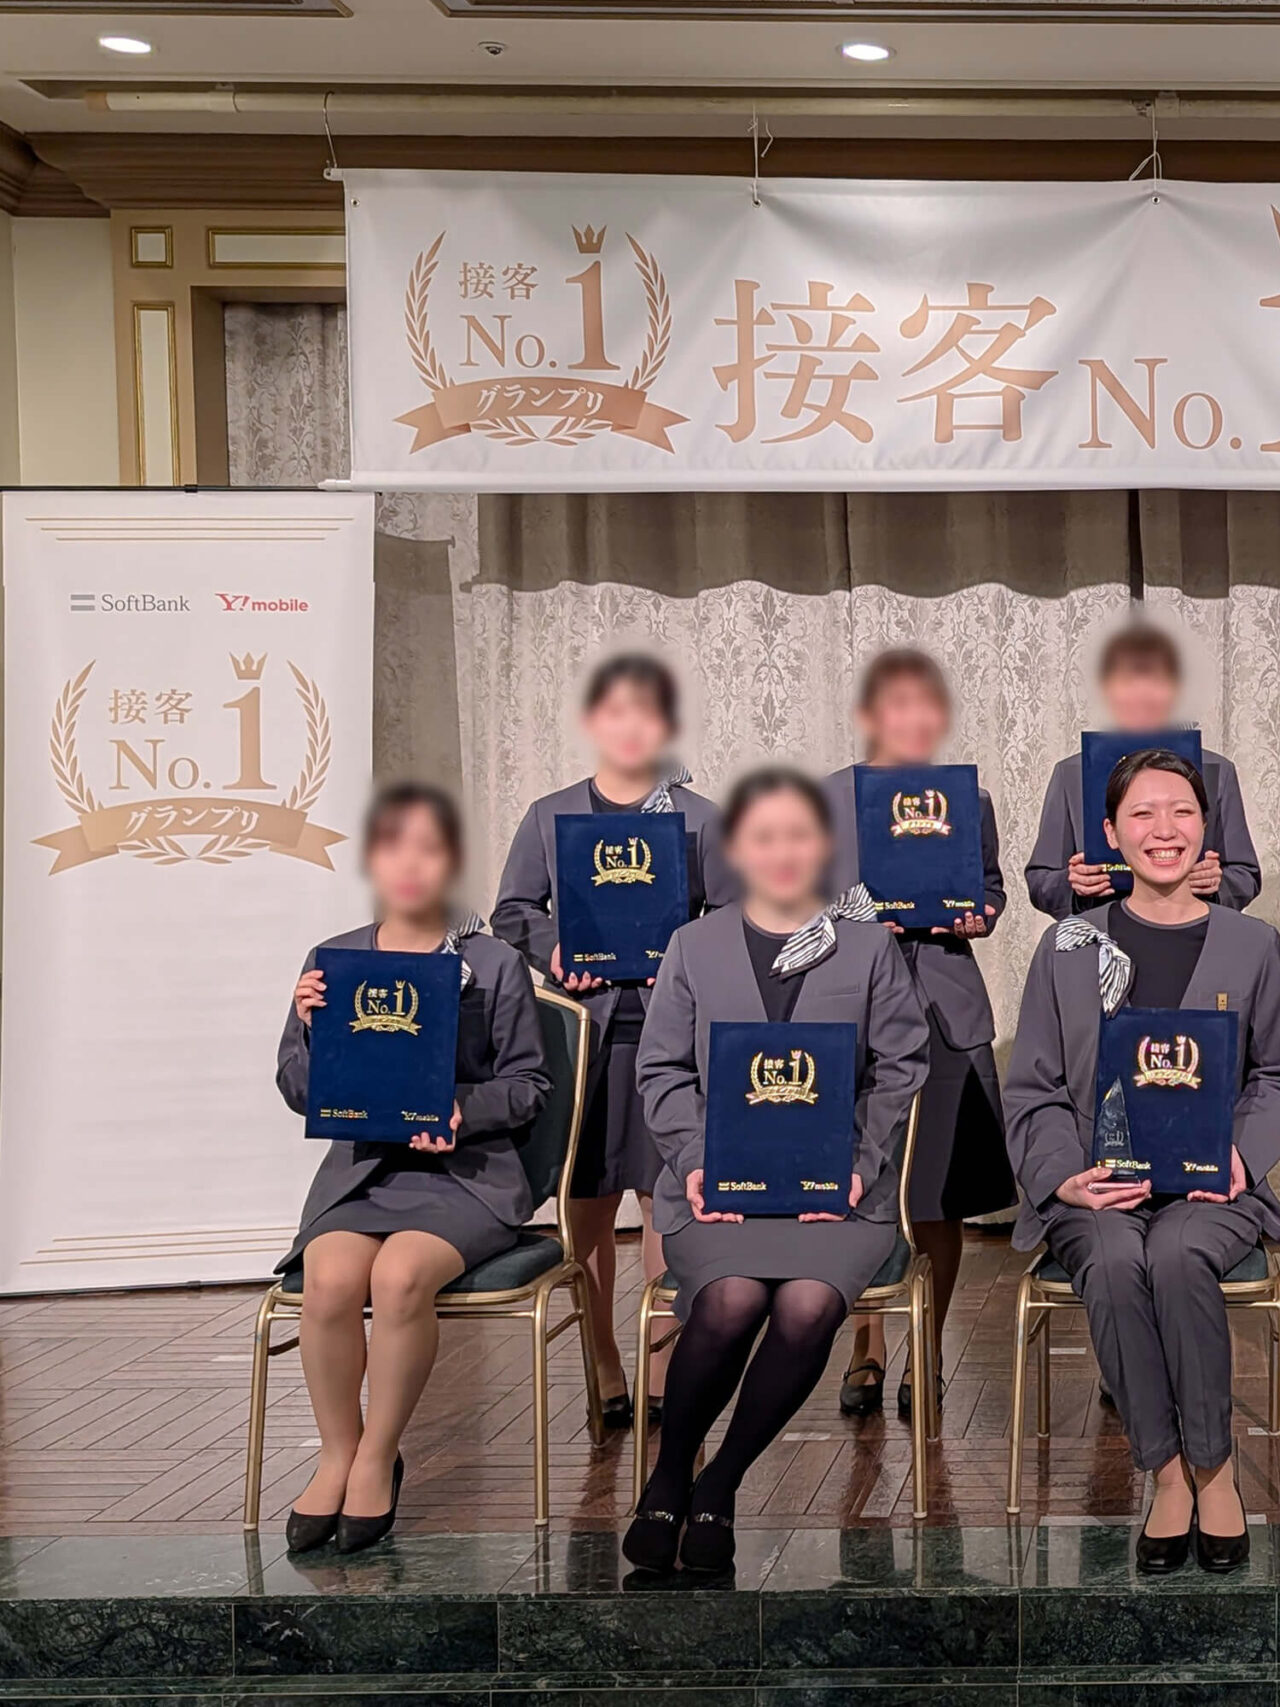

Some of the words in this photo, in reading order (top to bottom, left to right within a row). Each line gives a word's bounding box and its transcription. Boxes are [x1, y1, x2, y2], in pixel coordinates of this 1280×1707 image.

[459, 261, 538, 301] 接客
[711, 278, 1060, 446] 接客
[476, 382, 605, 419] グランプリ
[101, 593, 191, 613] SoftBank
[214, 592, 310, 613] Y!mobile
[108, 689, 193, 725] 接客
[124, 805, 260, 839] グランプリ
